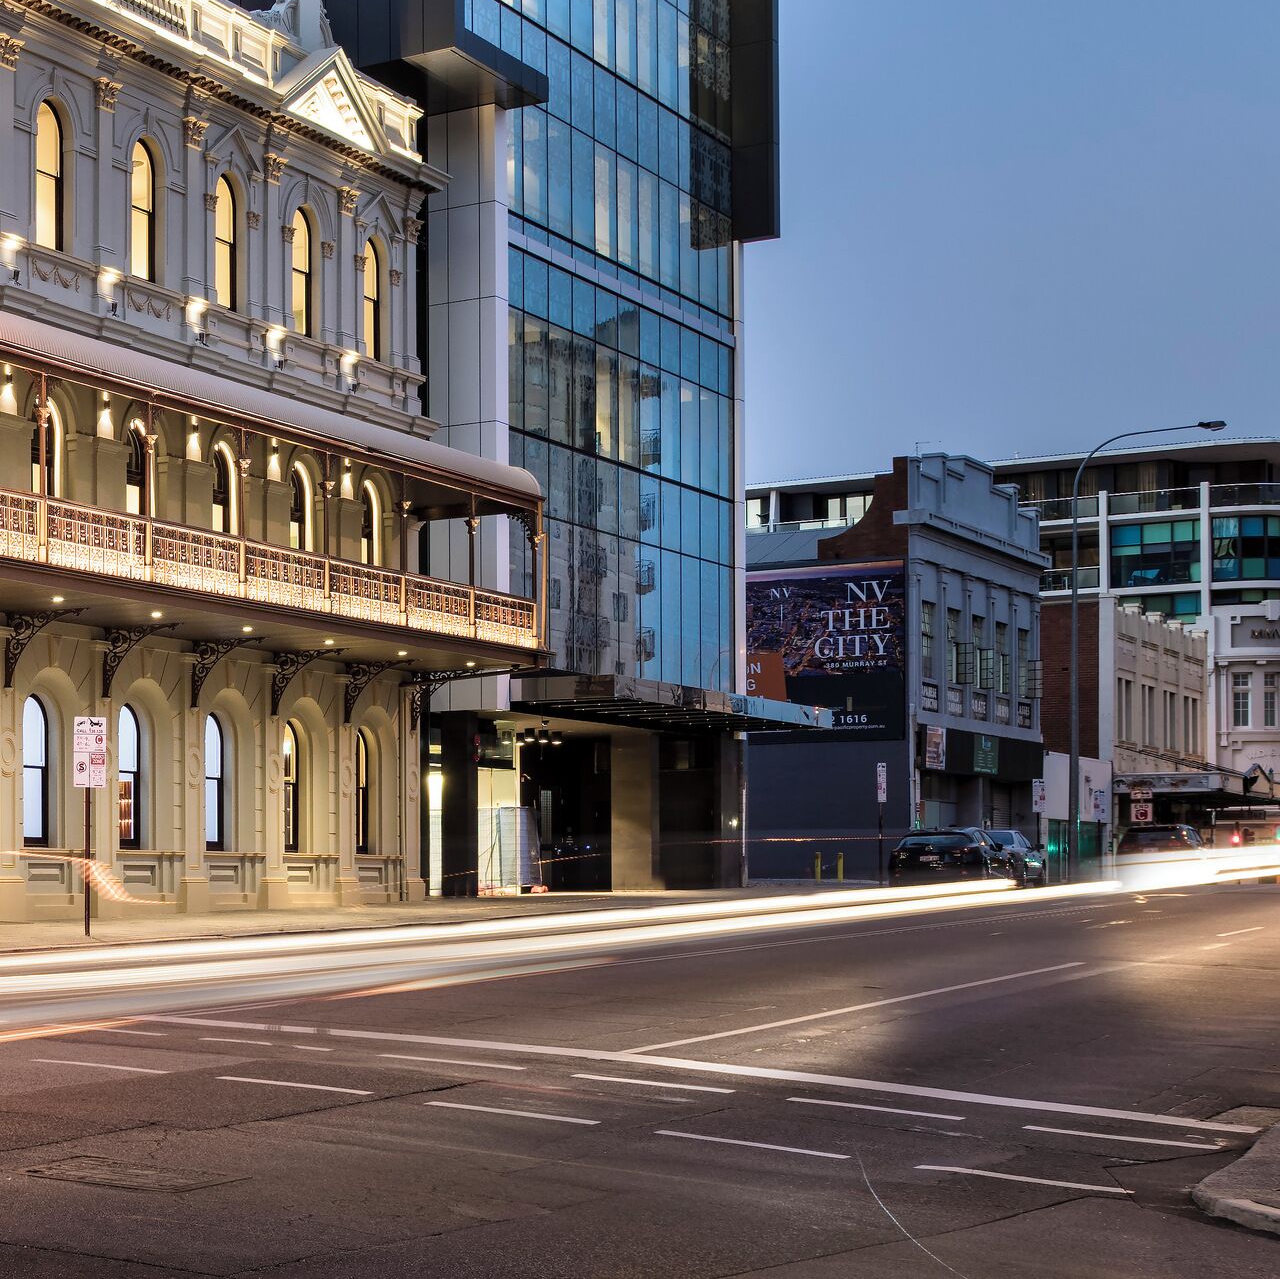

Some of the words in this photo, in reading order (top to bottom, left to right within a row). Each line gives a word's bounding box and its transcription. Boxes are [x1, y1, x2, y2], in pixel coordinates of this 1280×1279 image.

[770, 588, 790, 601] NV
[844, 580, 892, 604] NV
[820, 607, 890, 632] THE
[815, 633, 892, 659] CITY
[842, 660, 875, 668] MURRAY
[840, 714, 868, 724] 1616
